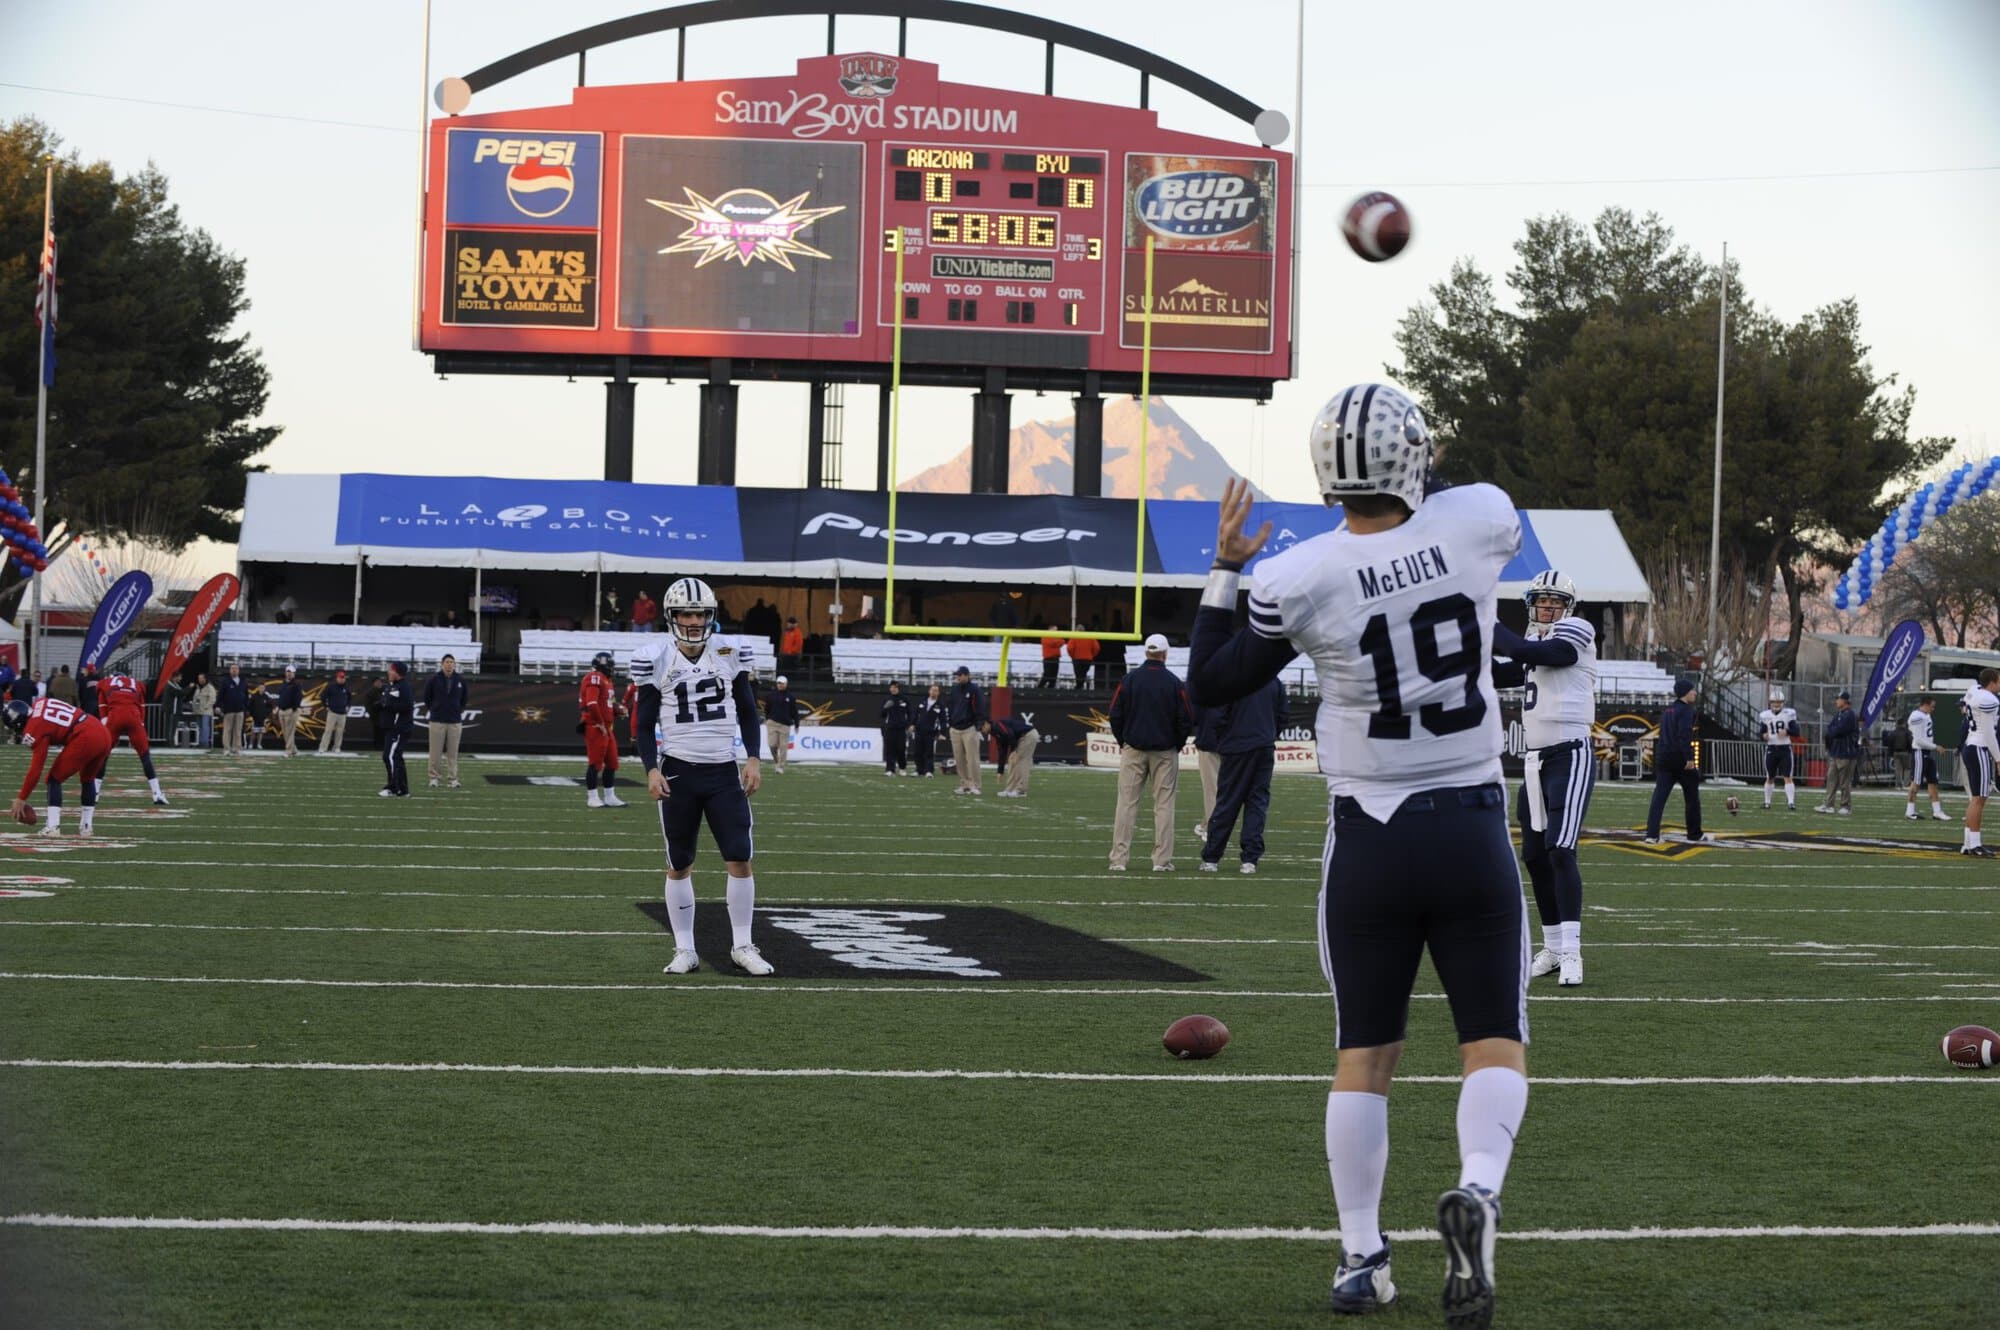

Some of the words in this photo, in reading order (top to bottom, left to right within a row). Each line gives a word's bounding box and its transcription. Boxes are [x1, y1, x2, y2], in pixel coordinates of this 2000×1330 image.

[715, 91, 782, 124] Sam
[778, 90, 885, 138] Boyd
[893, 104, 1018, 133] STADIUM
[473, 138, 577, 166] PEPSI
[907, 148, 974, 170] ARIZONA
[1036, 154, 1070, 174] BYU
[925, 172, 952, 203] 0
[1068, 178, 1094, 209] 0
[1157, 177, 1245, 200] BUD
[1146, 197, 1255, 221] LIGHT
[700, 223, 731, 235] LAS
[735, 223, 789, 237] VEGAS
[884, 229, 899, 252] 3
[932, 212, 1055, 247] 58:06
[1065, 233, 1085, 243] TIME
[1062, 243, 1086, 253] OUTS
[1063, 252, 1085, 262] LEFT
[1087, 238, 1101, 260] 3
[458, 247, 586, 277] SAM'S
[935, 258, 1051, 279] UNLVtickets.com
[458, 275, 587, 302] TOWN
[944, 283, 960, 295] TO
[964, 284, 983, 296] GO
[995, 286, 1026, 297] BALL
[1028, 287, 1047, 298] ON
[458, 299, 491, 310] HOTEL
[494, 301, 502, 310] &
[503, 301, 557, 312] GAMBLING
[559, 302, 585, 313] HALL
[1125, 294, 1269, 314] SUMMERLIN
[379, 516, 532, 529] FURNITURE
[548, 520, 699, 541] GALLERIES
[800, 511, 1097, 546] Pioneer
[1357, 545, 1449, 599] McEUEN
[109, 581, 138, 628] LIGHT
[174, 576, 233, 659] Budweiser
[1358, 592, 1488, 739] 19
[1866, 681, 1887, 716] BUD
[1886, 630, 1914, 677] LIGHT
[672, 674, 727, 724] 12
[43, 698, 77, 727] 60
[800, 736, 871, 750] Chevron
